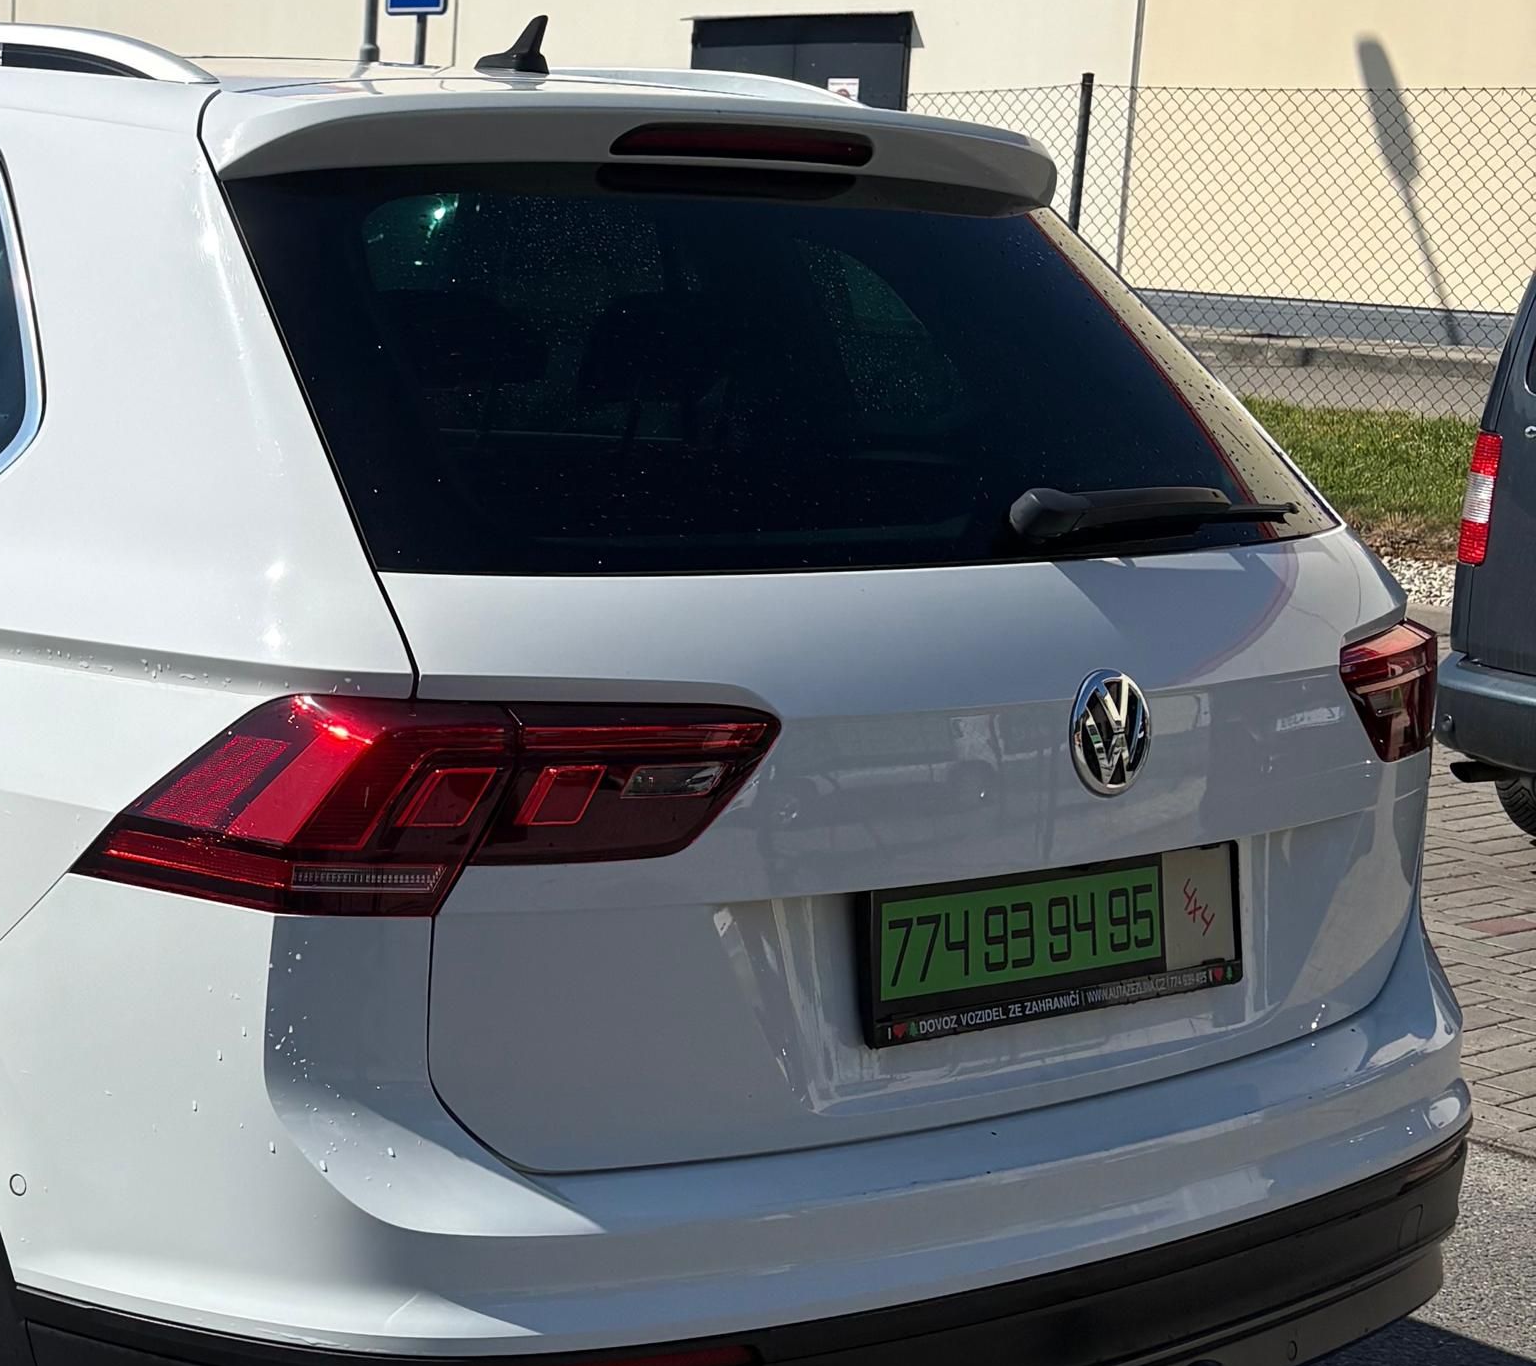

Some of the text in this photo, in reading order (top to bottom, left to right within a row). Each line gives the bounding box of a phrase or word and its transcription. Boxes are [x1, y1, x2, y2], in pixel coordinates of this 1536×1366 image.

[888, 883, 1154, 987] 774 93 94 95
[919, 1016, 958, 1034] DOVOZ
[960, 1008, 1007, 1027] VOZIDEL
[1008, 1003, 1024, 1017] ZE
[1025, 989, 1080, 1015] ZAHRANIČÍ
